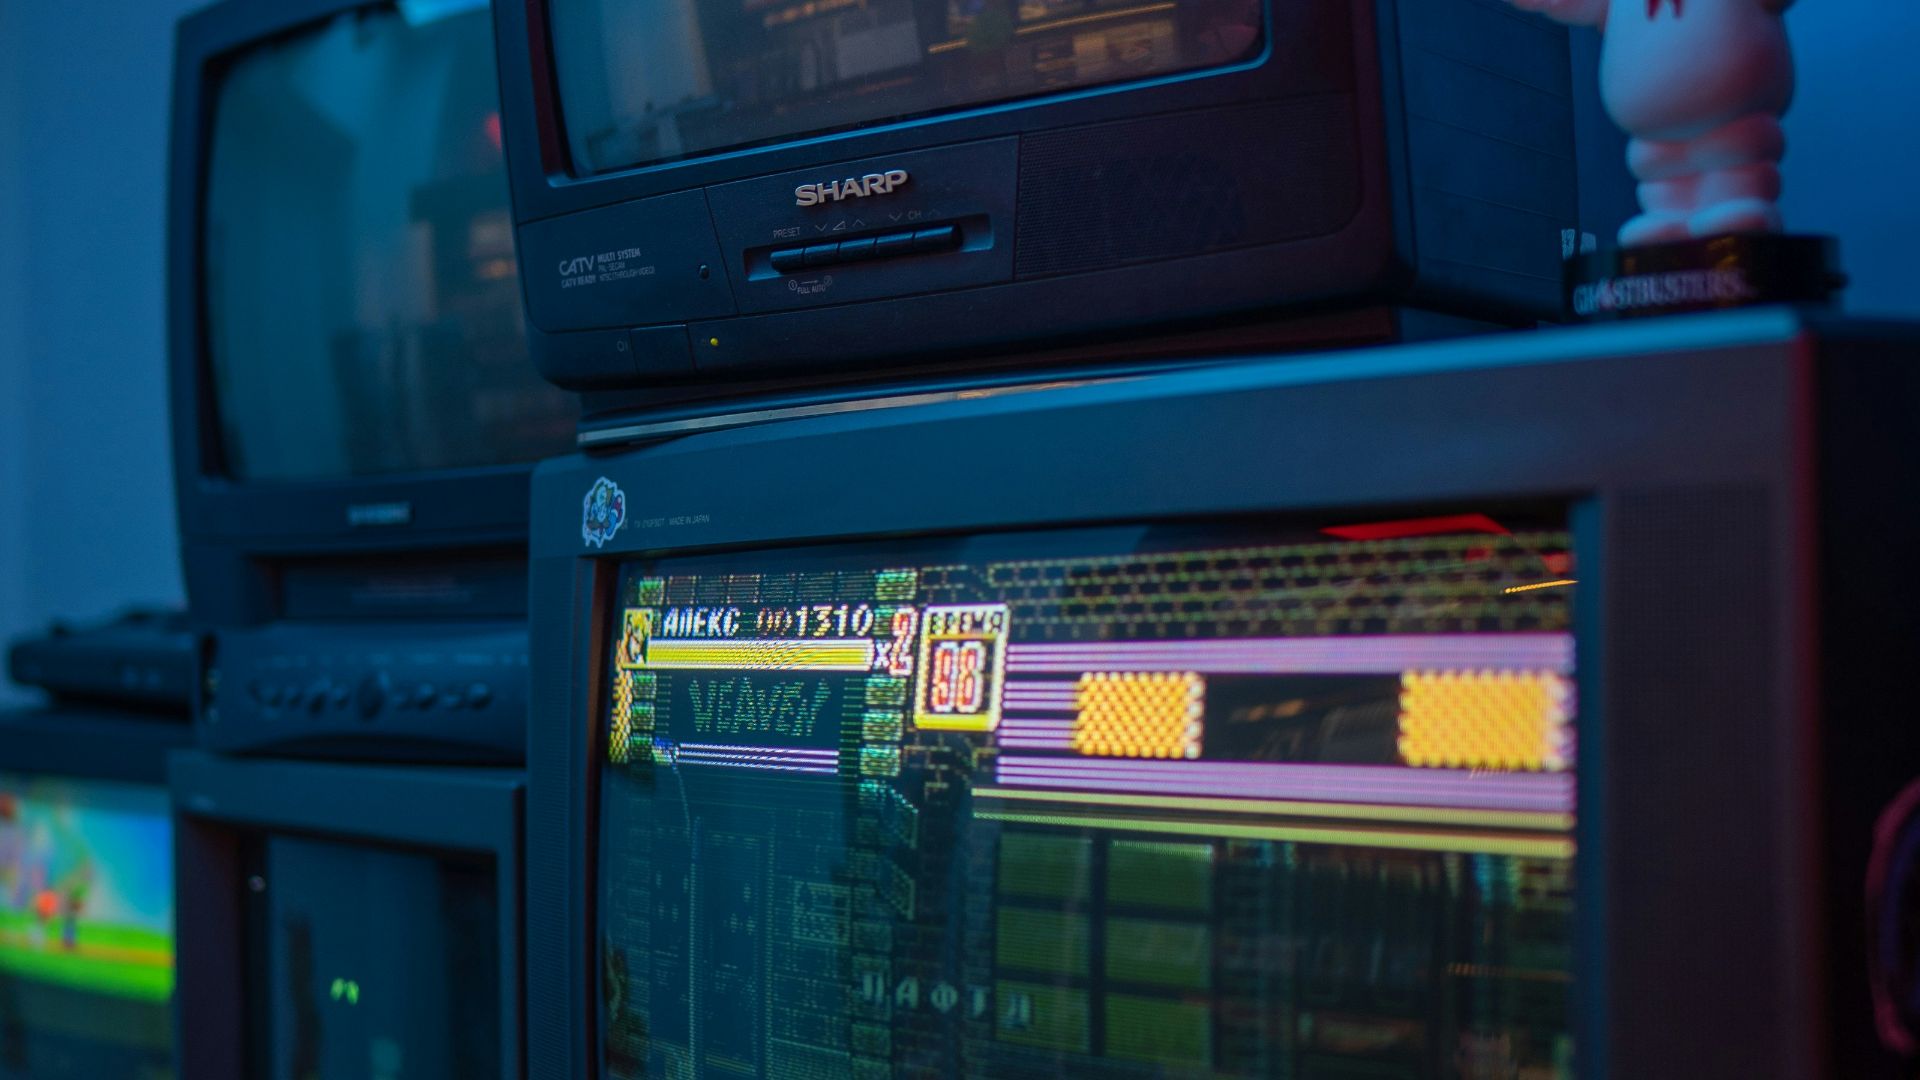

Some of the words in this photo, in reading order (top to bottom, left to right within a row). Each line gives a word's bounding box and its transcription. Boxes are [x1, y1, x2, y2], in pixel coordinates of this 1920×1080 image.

[795, 169, 909, 207] SHARP
[773, 226, 801, 239] PRESET
[618, 248, 641, 260] SYSTEM
[559, 256, 594, 276] CATV
[931, 640, 987, 714] 98
